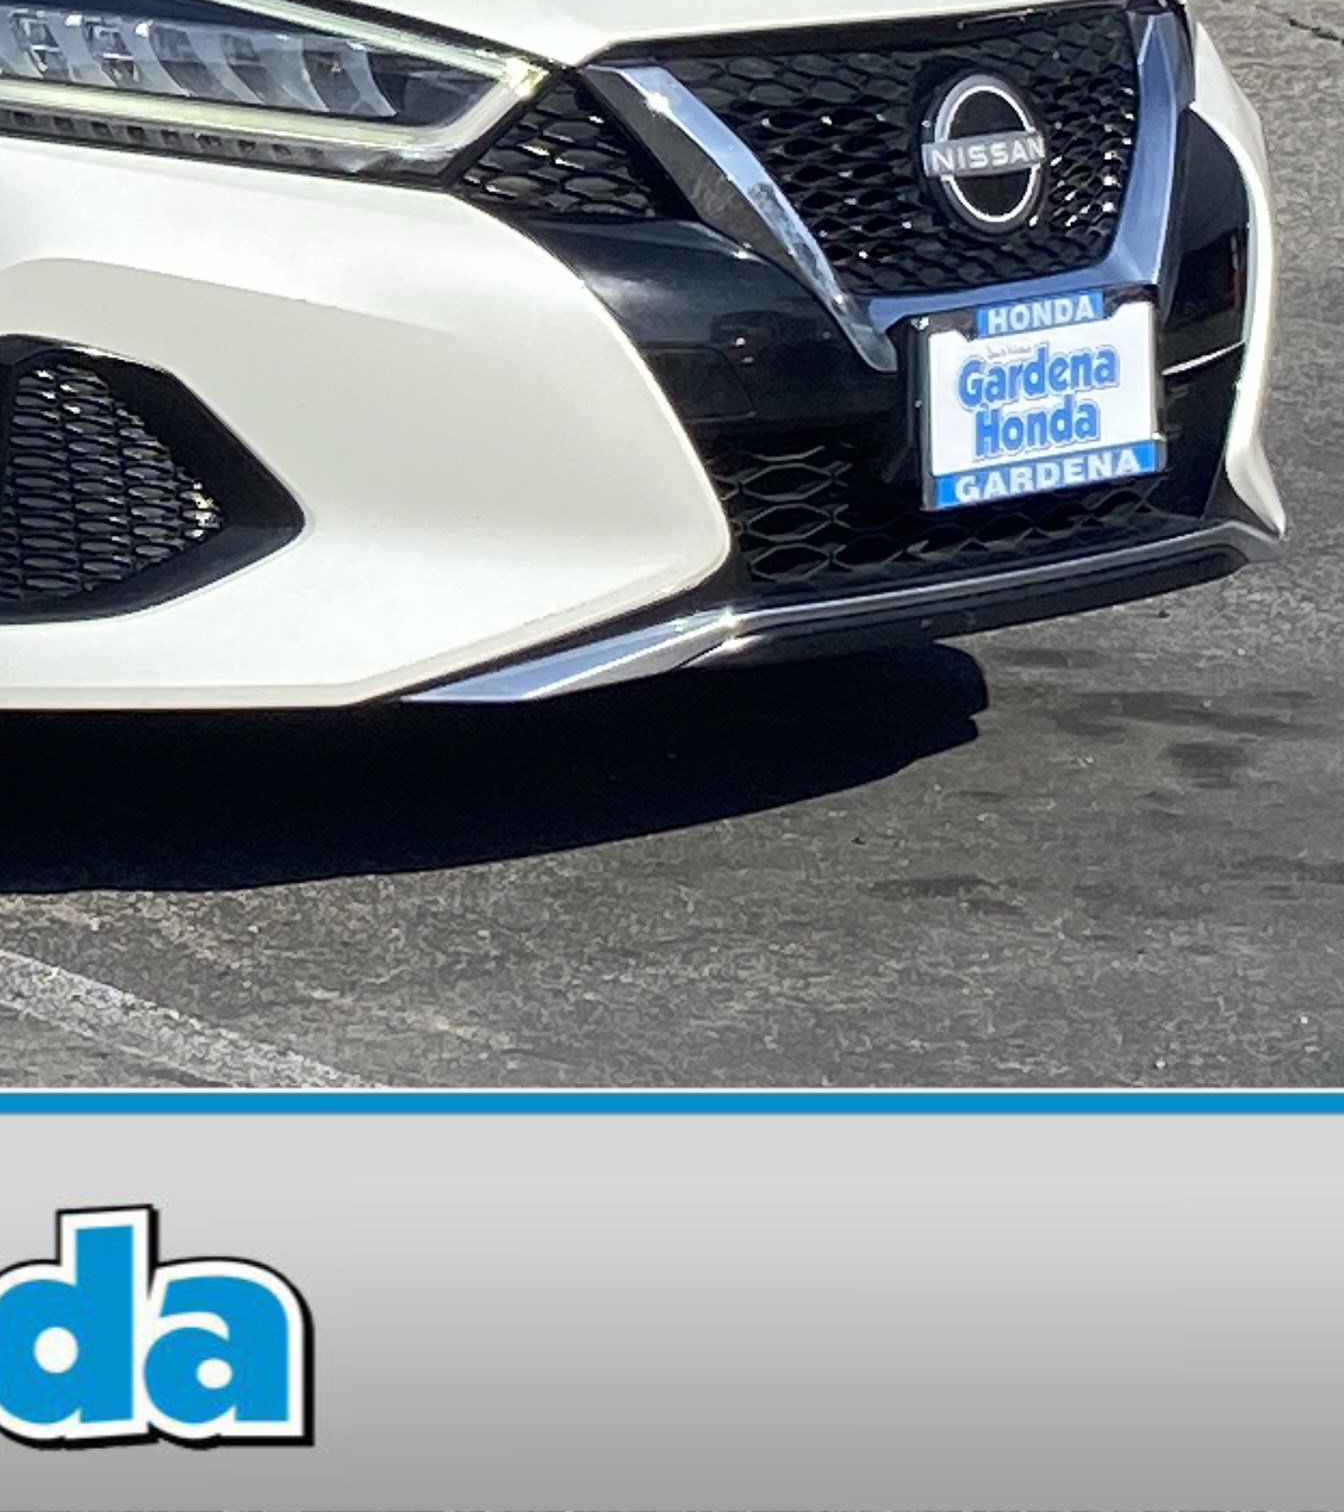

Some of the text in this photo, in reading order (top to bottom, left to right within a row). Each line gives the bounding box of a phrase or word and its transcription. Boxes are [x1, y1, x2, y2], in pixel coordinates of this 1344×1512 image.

[931, 135, 1045, 172] NISSAN
[987, 294, 1095, 335] HONDA
[957, 342, 1119, 410] Gardena
[973, 394, 1099, 459] Honda
[954, 449, 1141, 503] GARDENA
